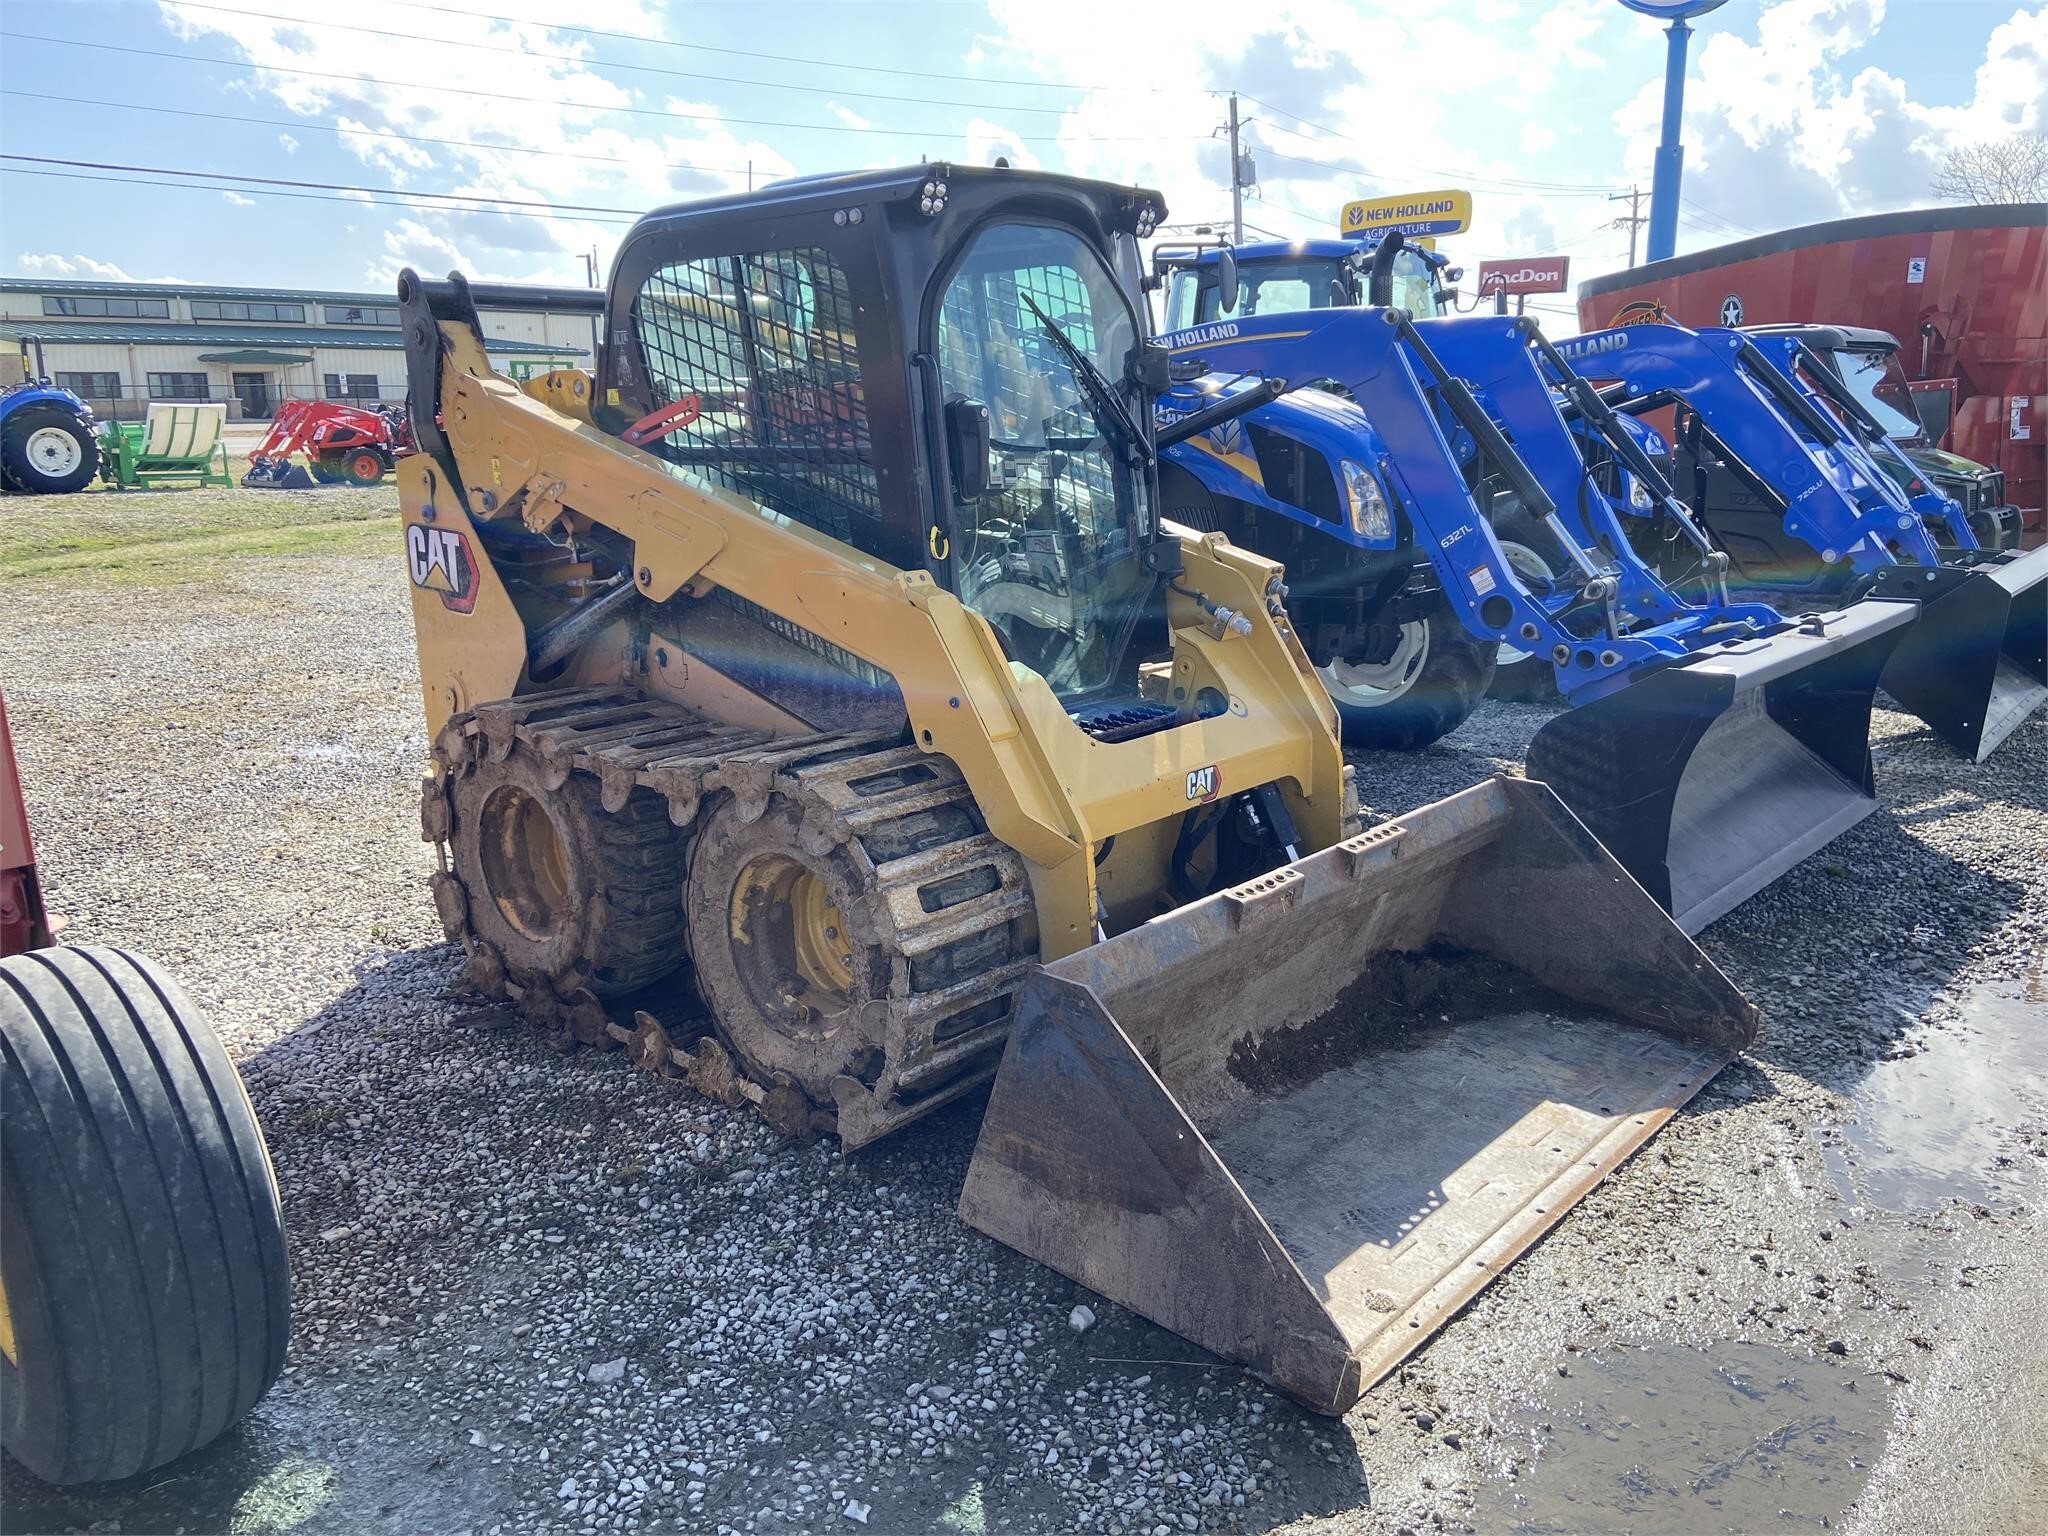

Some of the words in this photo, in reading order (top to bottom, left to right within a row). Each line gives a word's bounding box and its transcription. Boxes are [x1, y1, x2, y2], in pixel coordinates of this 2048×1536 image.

[1366, 207, 1394, 221] NEW
[1396, 199, 1454, 217] HOLLAND
[1481, 268, 1558, 287] MacDon
[1176, 323, 1239, 347] HOLLAND
[1797, 479, 1823, 502] 720LU
[1440, 524, 1473, 549] 632TL
[407, 525, 460, 593] CAT
[1186, 766, 1214, 800] CAT
